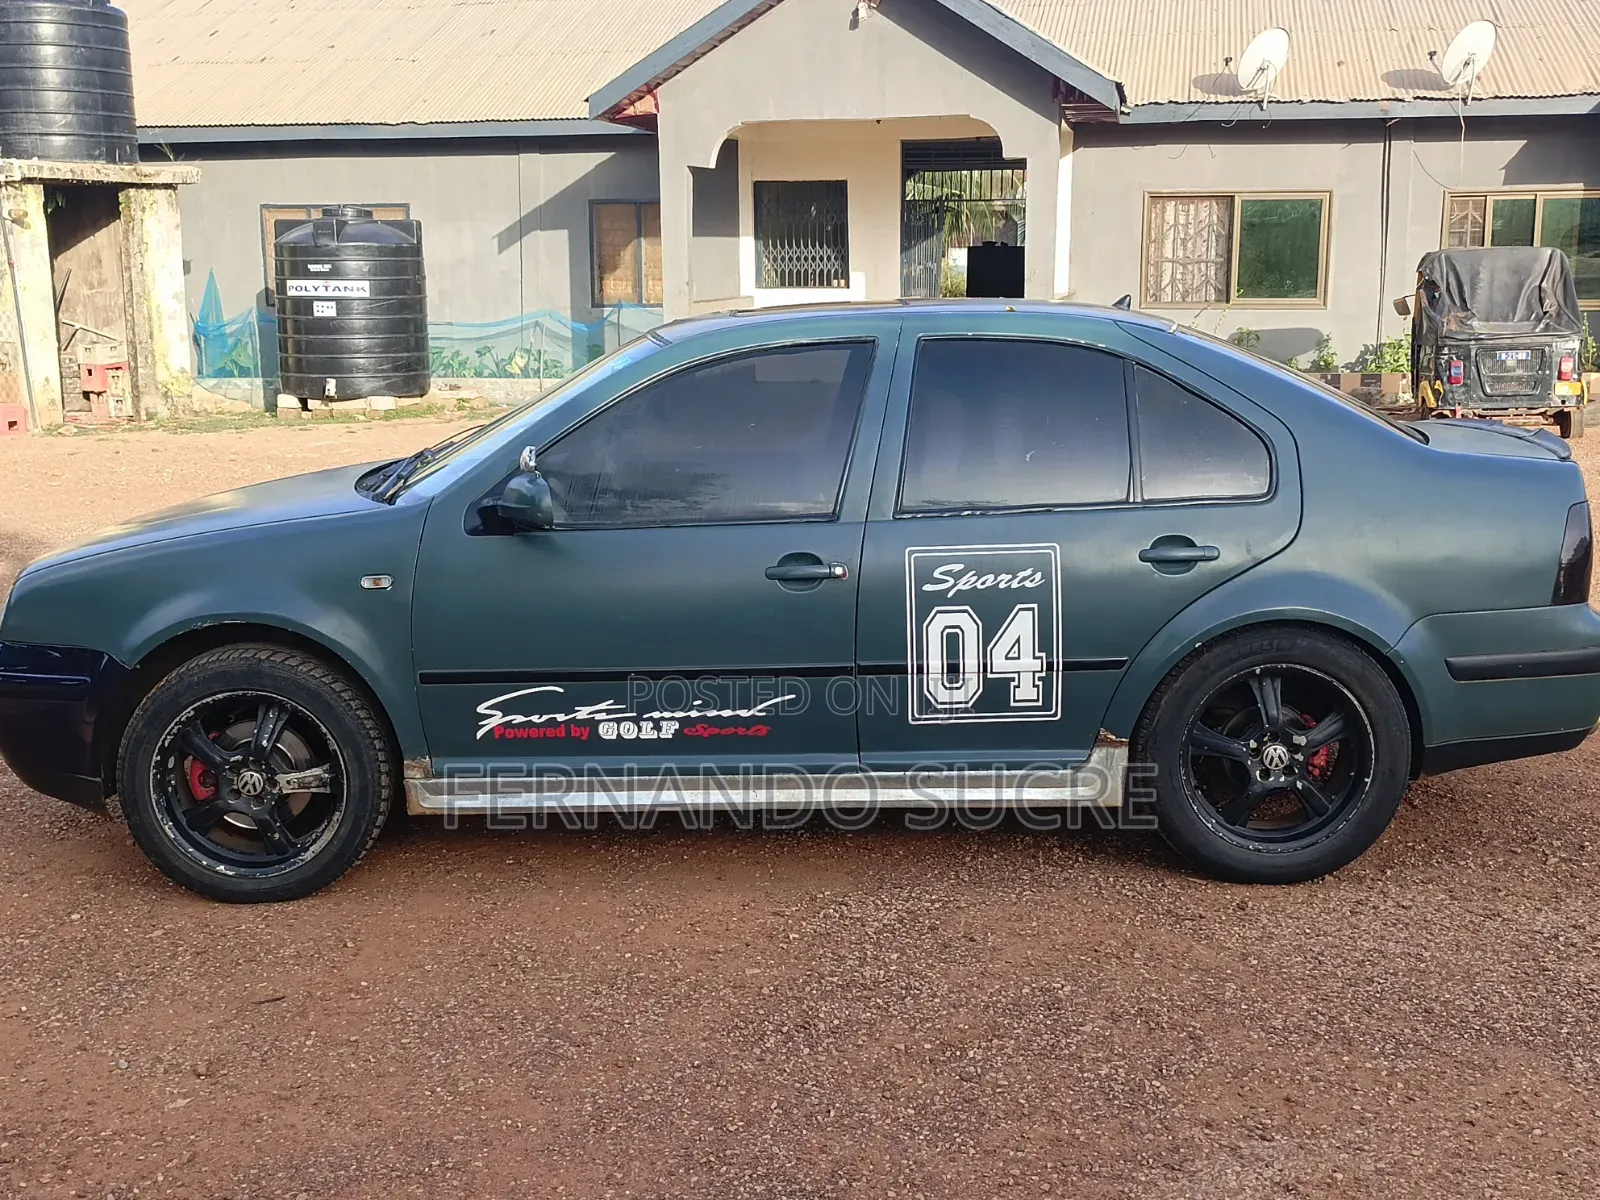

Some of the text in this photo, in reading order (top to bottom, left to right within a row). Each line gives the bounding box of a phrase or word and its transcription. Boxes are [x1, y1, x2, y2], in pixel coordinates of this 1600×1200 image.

[288, 285, 367, 293] POLYTANK
[921, 563, 1046, 598] Sports
[923, 604, 1046, 709] 04
[493, 724, 566, 740] Powered
[570, 724, 591, 740] by
[598, 721, 680, 740] GOLF
